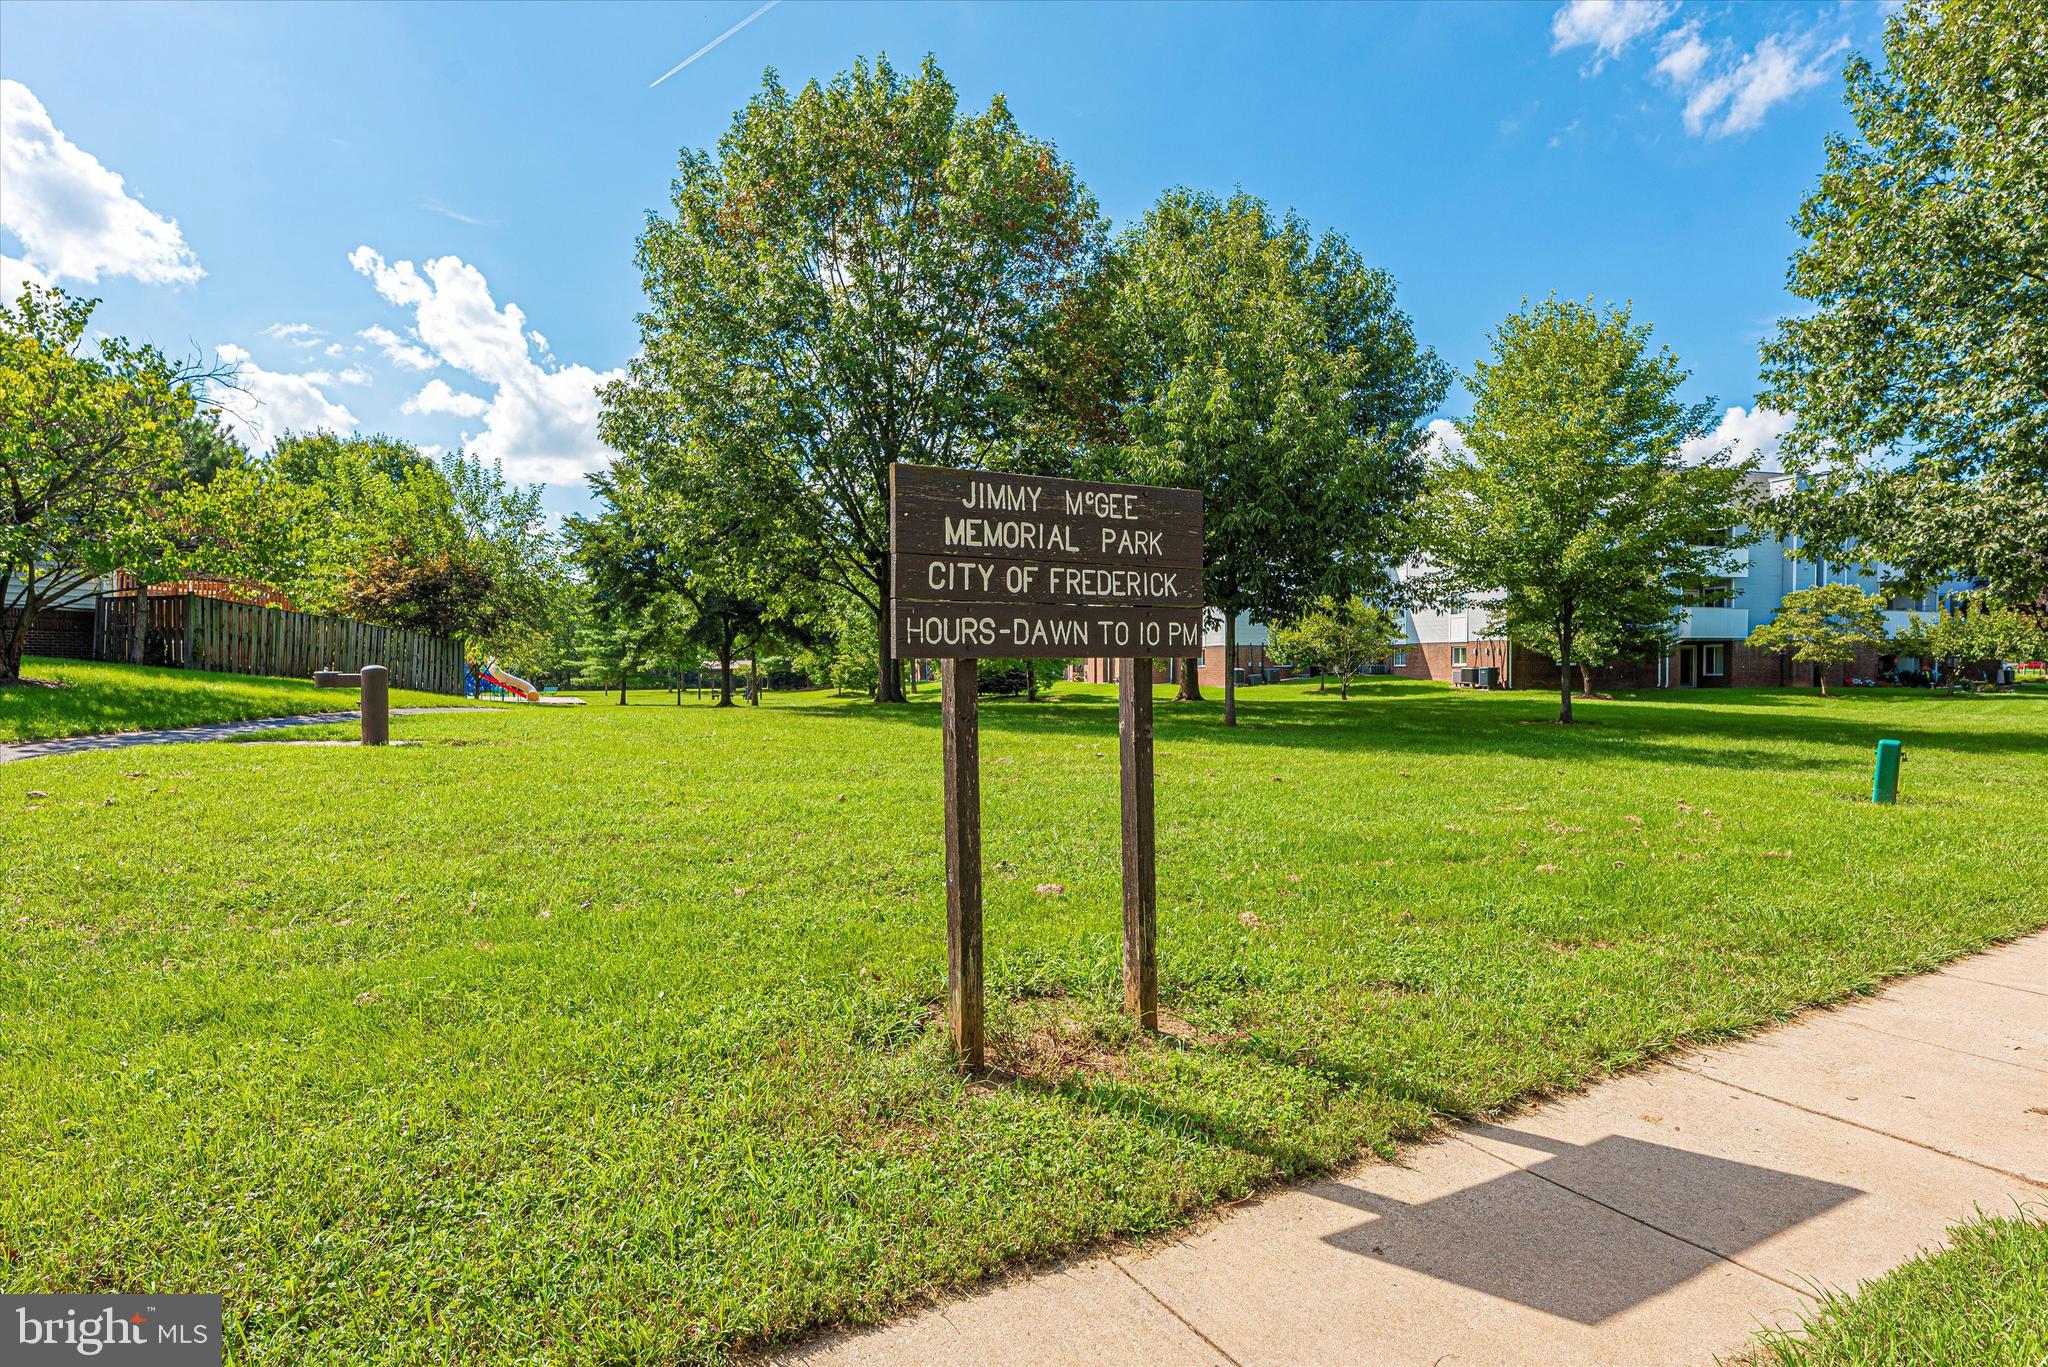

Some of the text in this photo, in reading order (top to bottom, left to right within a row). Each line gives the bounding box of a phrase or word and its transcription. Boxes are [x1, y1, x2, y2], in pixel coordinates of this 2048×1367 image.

[962, 481, 1042, 512] JIMMY
[945, 516, 1163, 556] MEMORIAL PARK
[928, 561, 1178, 597] CITY OF FREDERICK
[907, 616, 1199, 647] HOURS-DAWN TO 10 PM
